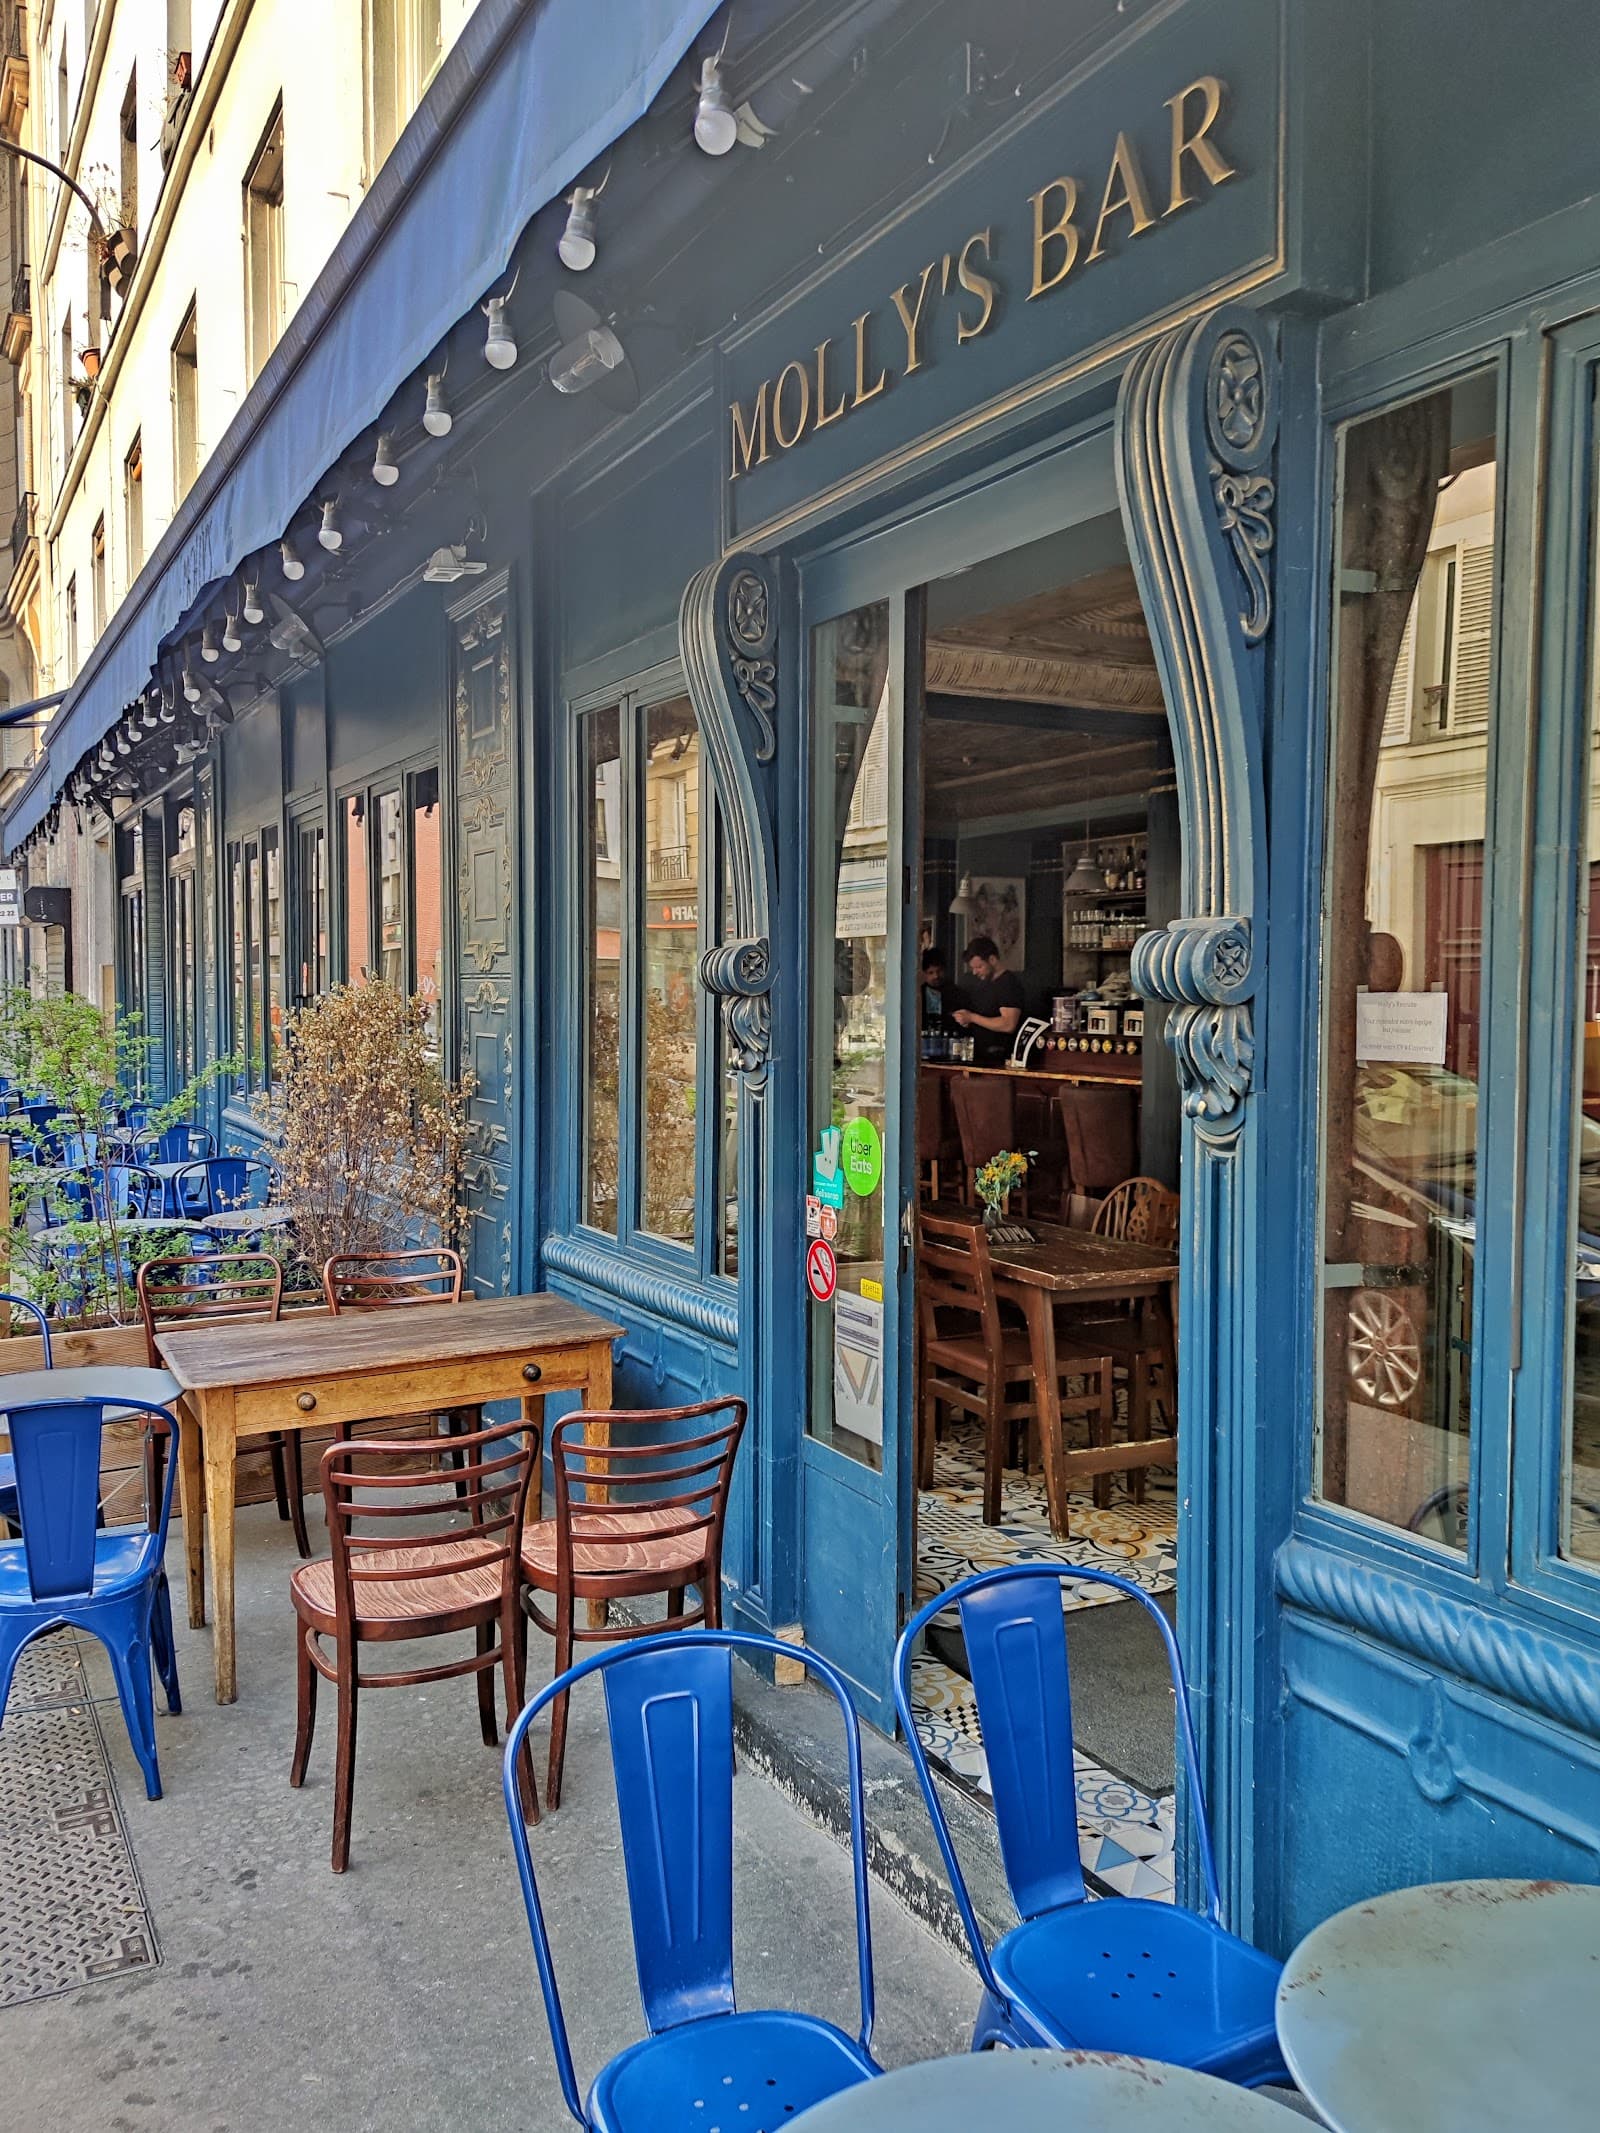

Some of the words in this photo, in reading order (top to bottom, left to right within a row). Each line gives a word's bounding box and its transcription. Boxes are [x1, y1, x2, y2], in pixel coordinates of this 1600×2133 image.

[729, 226, 997, 480] MOLLY'S
[1024, 75, 1236, 301] BAR
[850, 1137, 873, 1156] Uber
[850, 1155, 873, 1175] Eats
